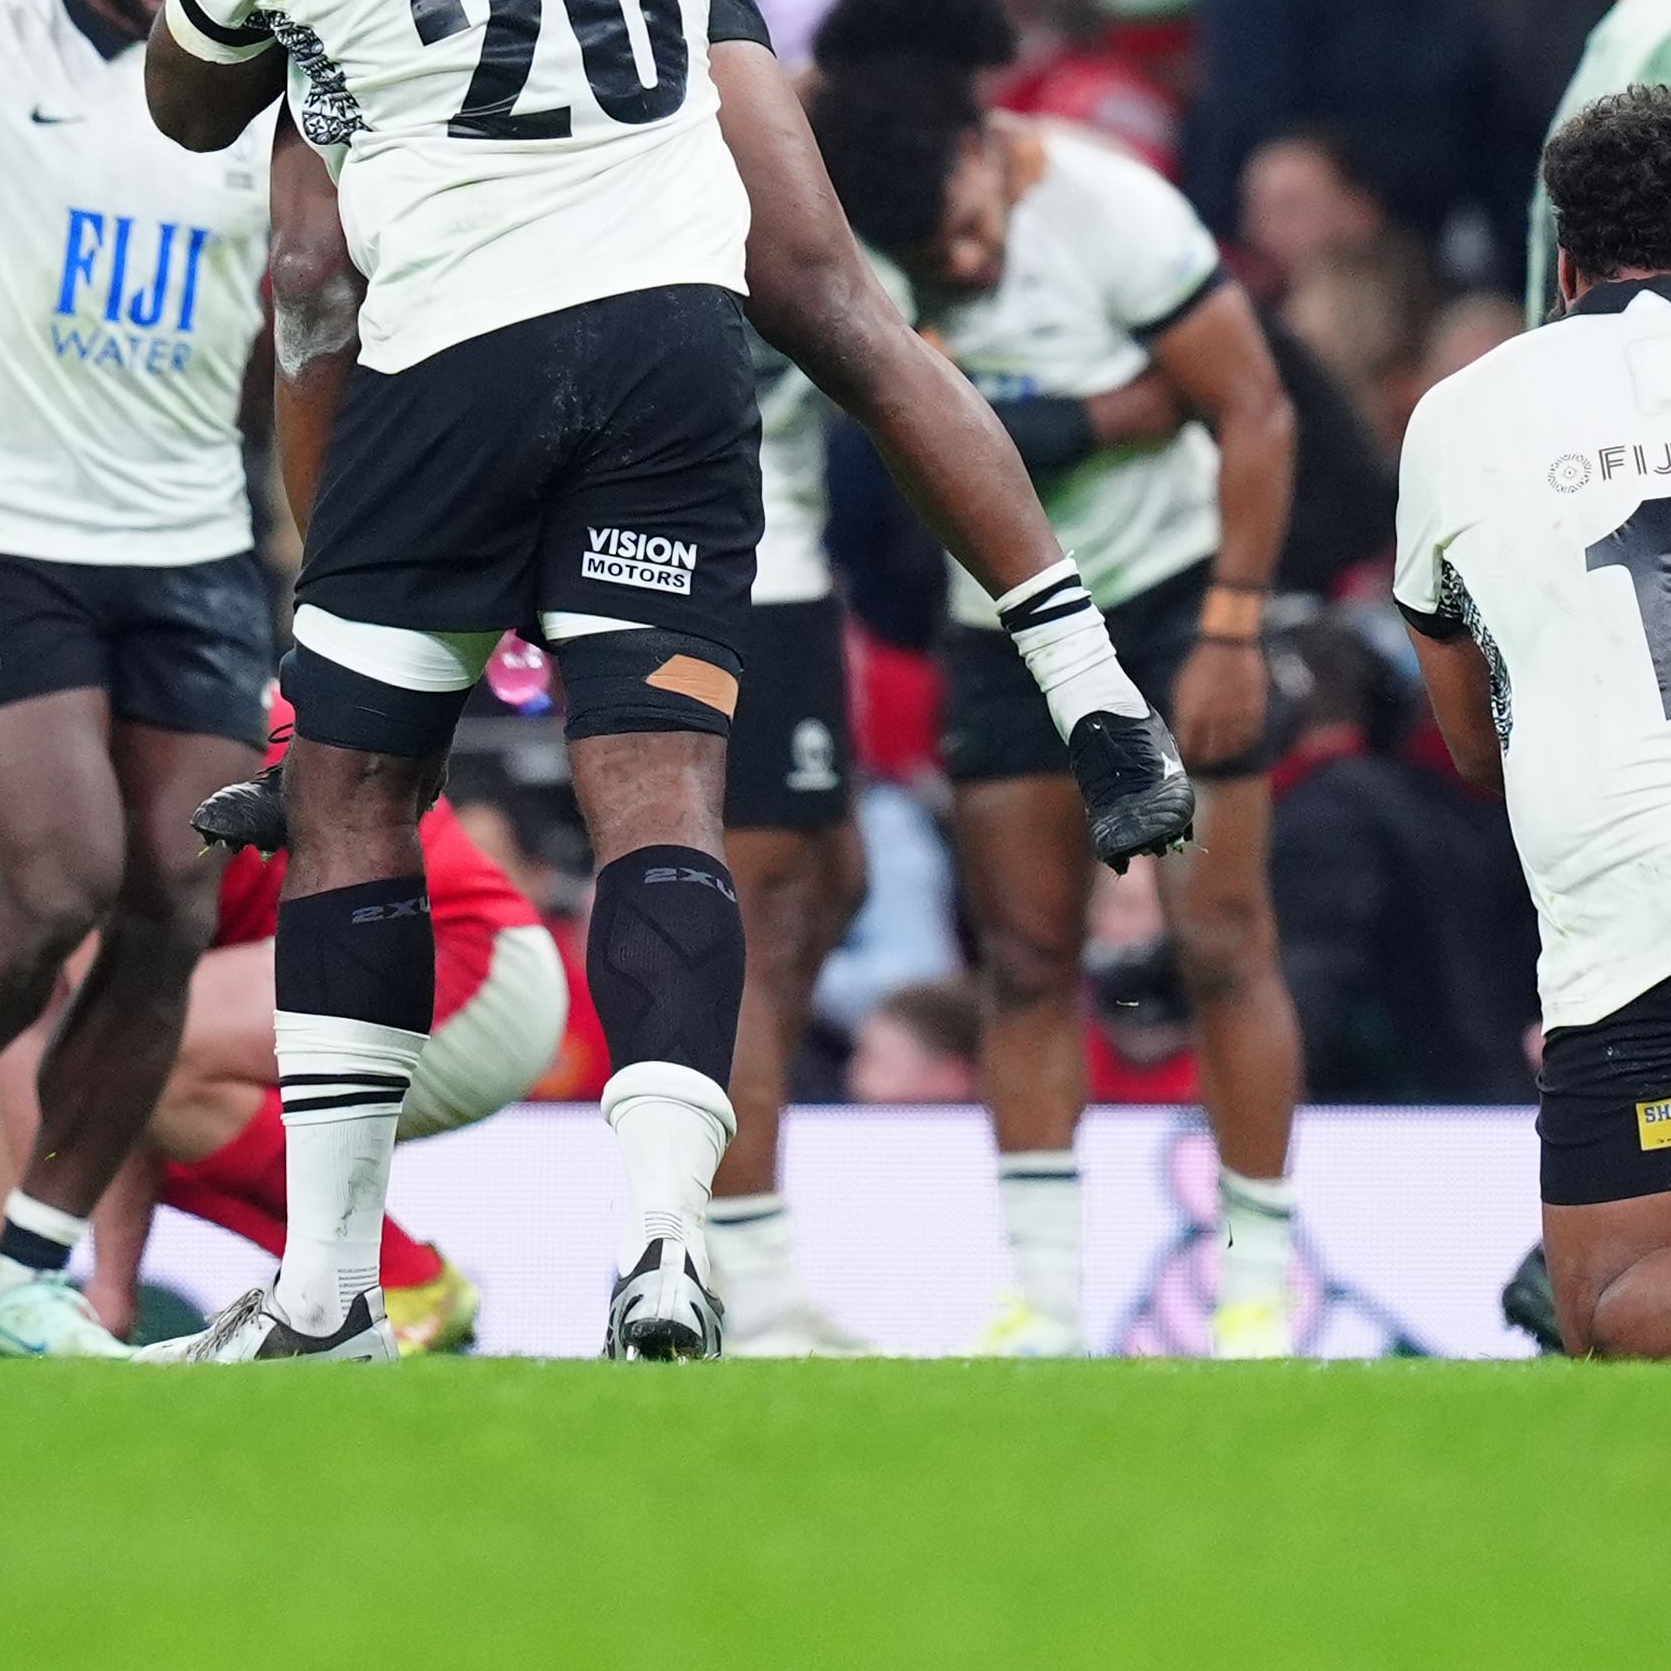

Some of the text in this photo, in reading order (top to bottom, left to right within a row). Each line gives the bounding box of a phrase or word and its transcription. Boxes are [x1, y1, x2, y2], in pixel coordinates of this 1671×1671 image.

[55, 209, 208, 331] FIJI
[51, 326, 192, 374] WATER
[586, 525, 698, 571] VISION
[587, 558, 685, 588] MOTORS
[643, 867, 738, 903] 2XU
